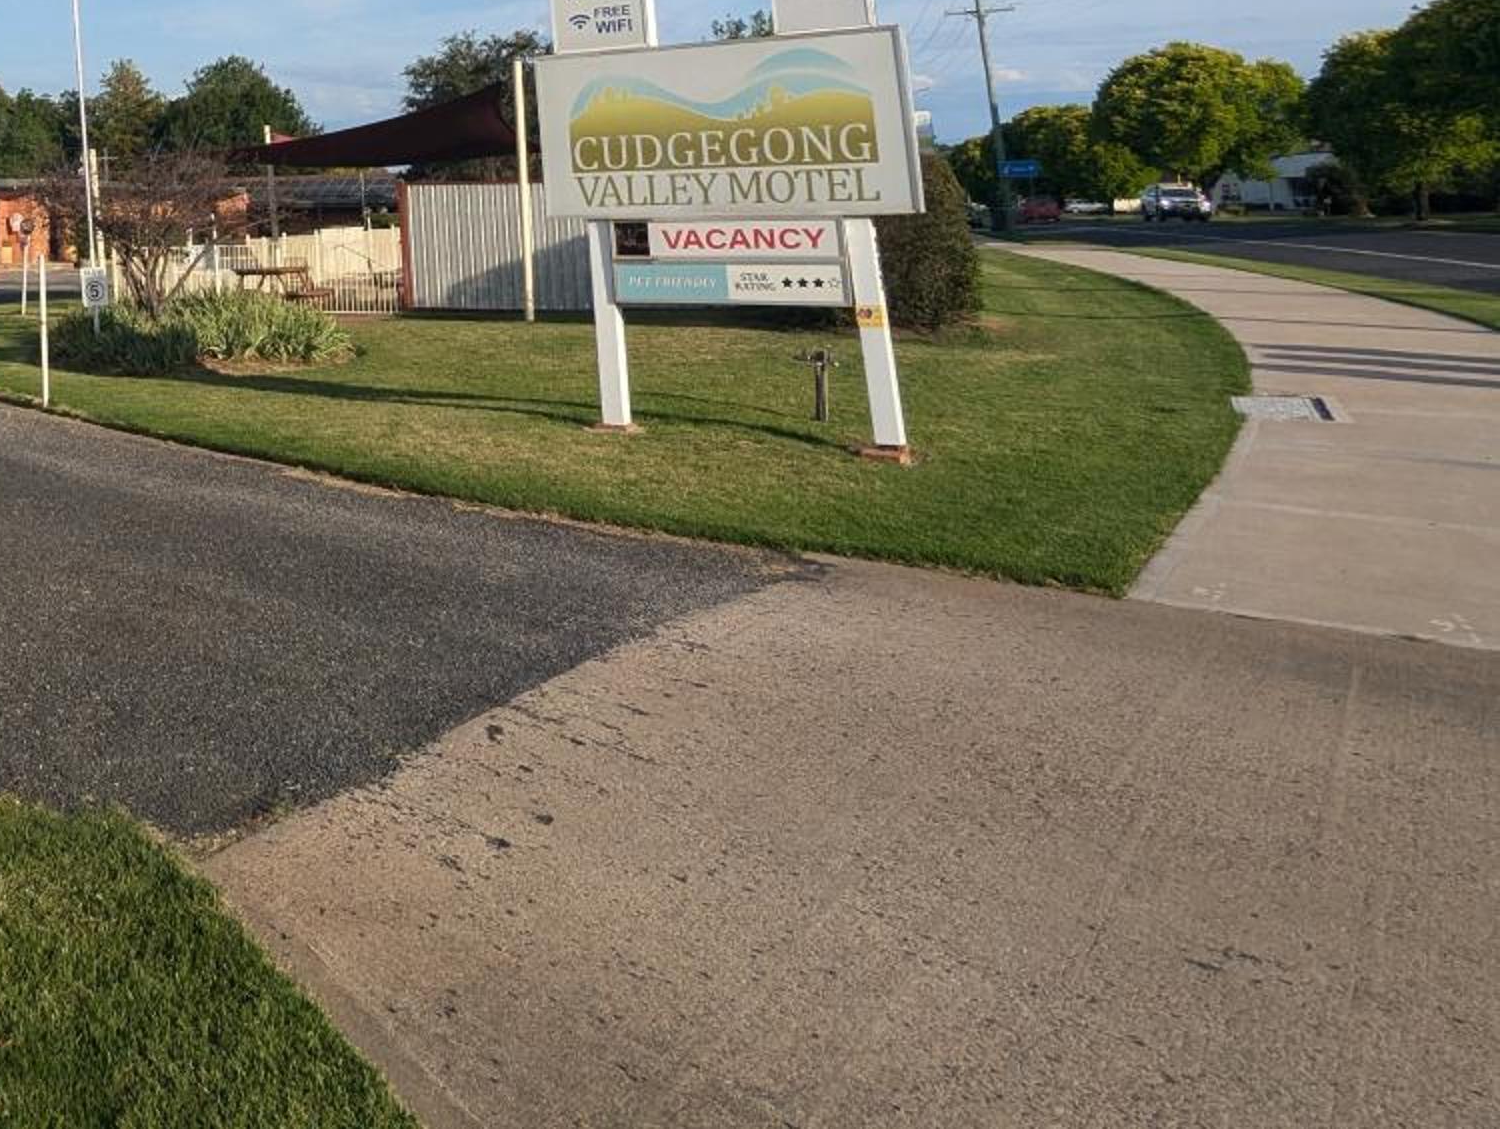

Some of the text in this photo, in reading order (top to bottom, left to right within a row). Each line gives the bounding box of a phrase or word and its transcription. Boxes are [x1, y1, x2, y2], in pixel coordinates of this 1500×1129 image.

[593, 4, 630, 18] FREE
[596, 18, 633, 33] WIFI
[573, 123, 871, 170] CUDGEGONG
[577, 168, 881, 207] VALLEY MOTEL
[661, 228, 825, 250] VACANCY
